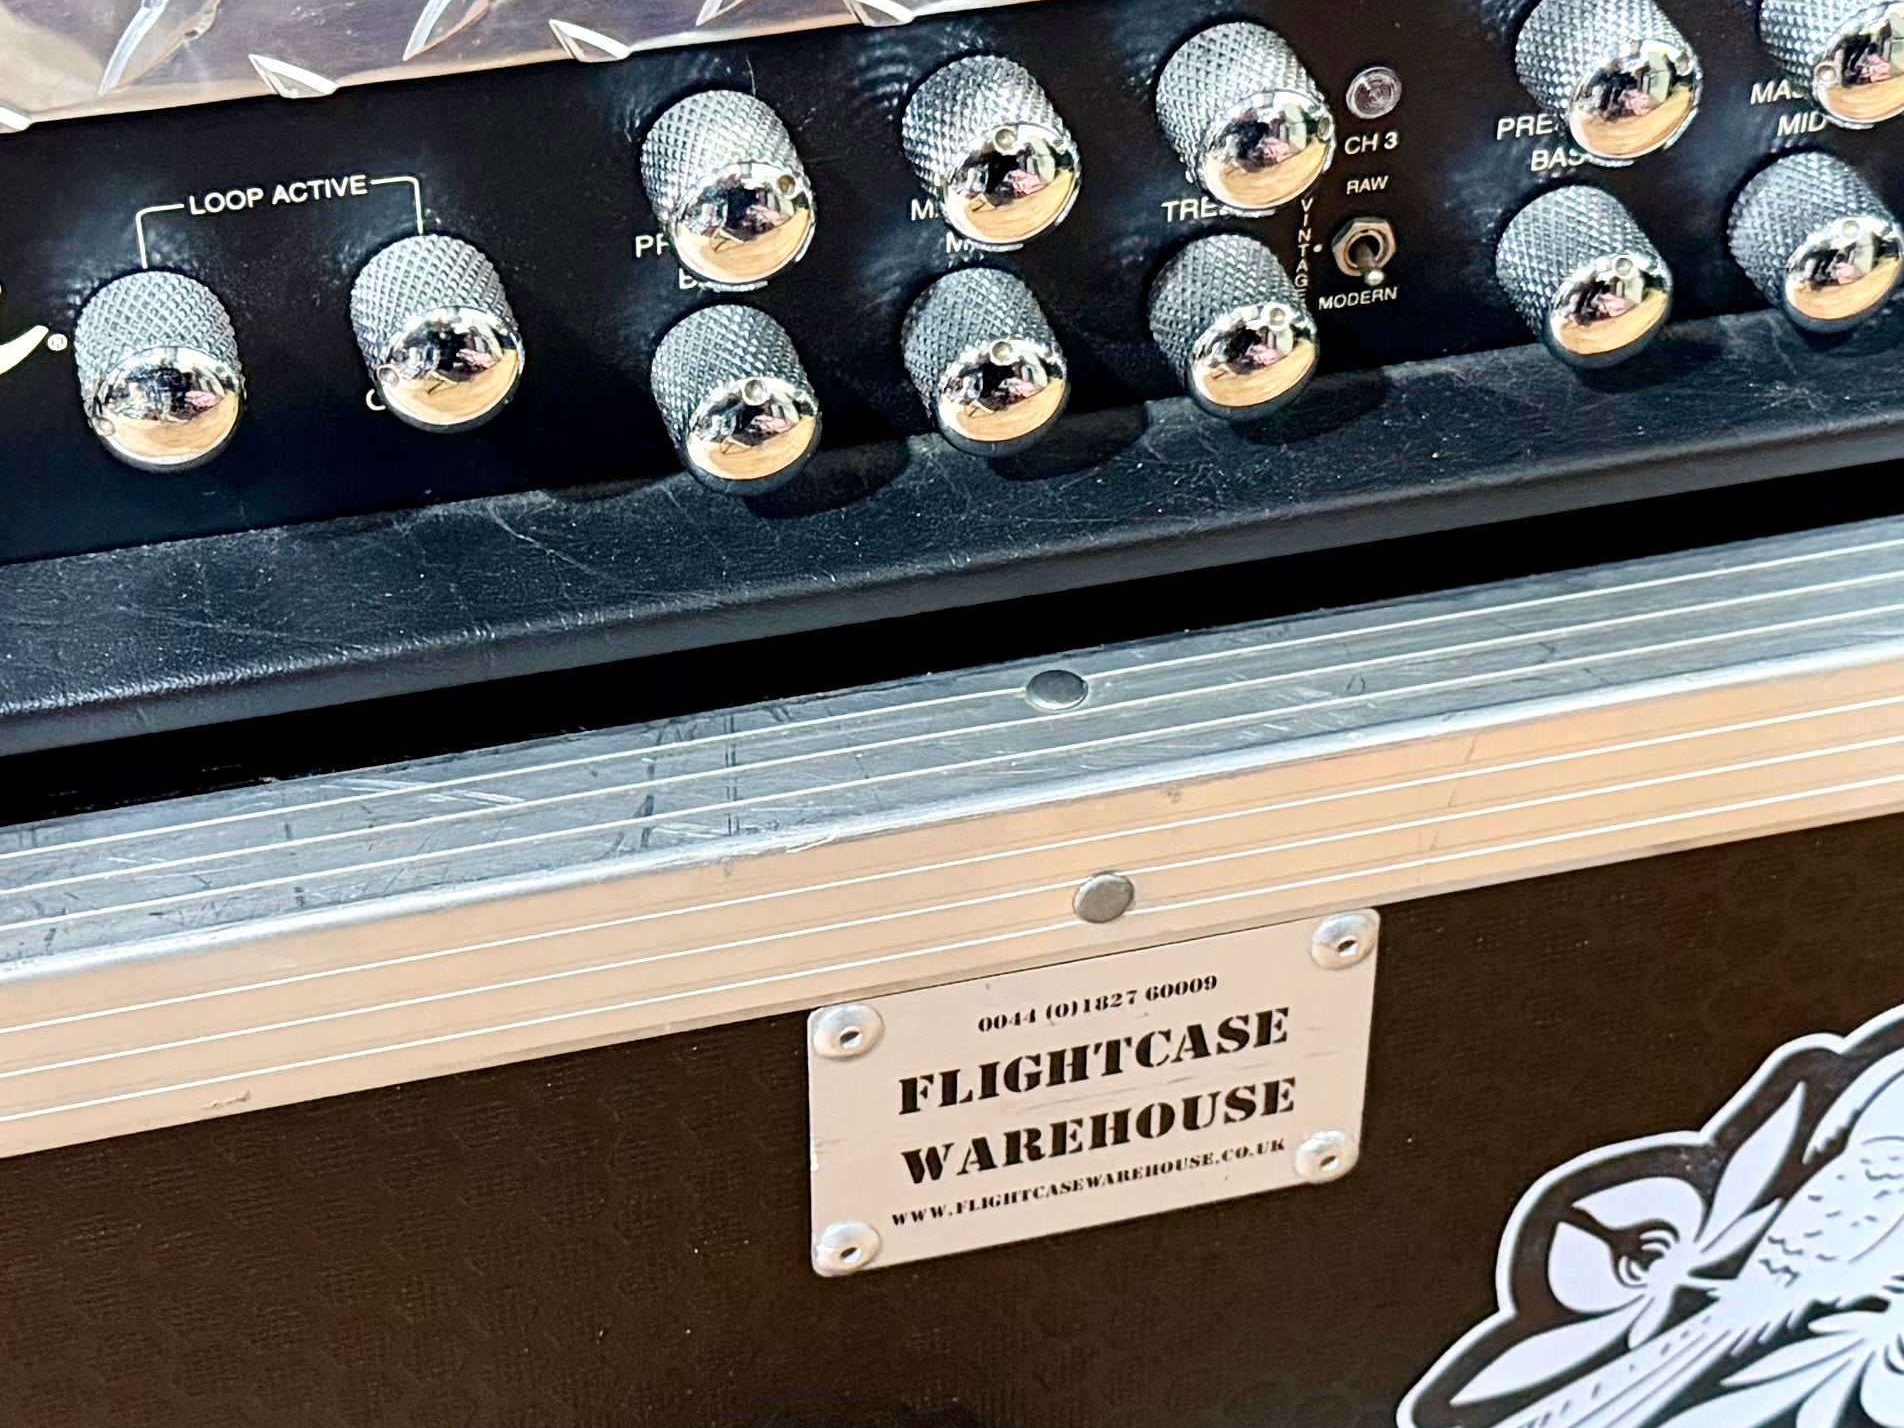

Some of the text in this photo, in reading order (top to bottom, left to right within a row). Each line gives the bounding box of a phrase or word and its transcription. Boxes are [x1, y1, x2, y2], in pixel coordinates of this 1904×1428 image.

[1777, 110, 1827, 137] MID
[1344, 131, 1399, 155] CH 3
[188, 175, 369, 216] LOOP ACTIVE
[1346, 175, 1389, 195] RAW
[1318, 285, 1399, 311] MODERN
[977, 1008, 1037, 1033] 0044
[1145, 975, 1218, 1002] 60009
[897, 1006, 1291, 1116] FLIGHTCASE
[900, 1076, 1297, 1186] WAREHOUSE
